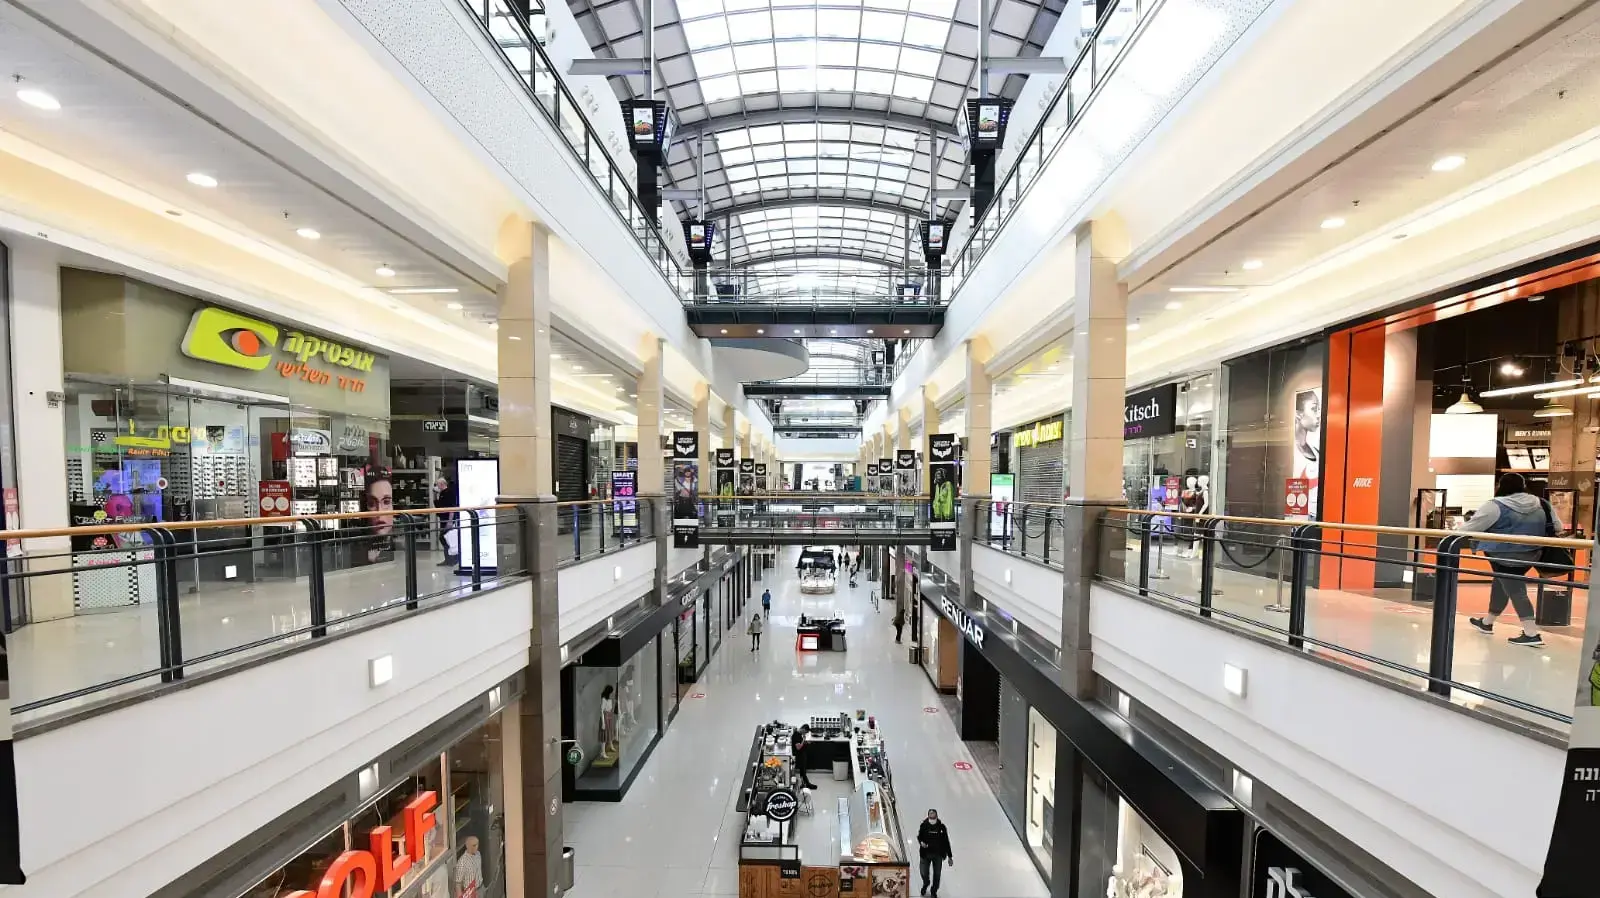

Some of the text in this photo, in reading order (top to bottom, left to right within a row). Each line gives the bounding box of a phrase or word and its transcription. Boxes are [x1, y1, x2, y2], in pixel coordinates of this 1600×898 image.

[283, 332, 375, 372] אופטיקה
[275, 361, 366, 392] הדור השלישי
[1353, 478, 1373, 488] NIKE
[941, 595, 984, 649] RENUAR
[284, 790, 437, 898] OLF
